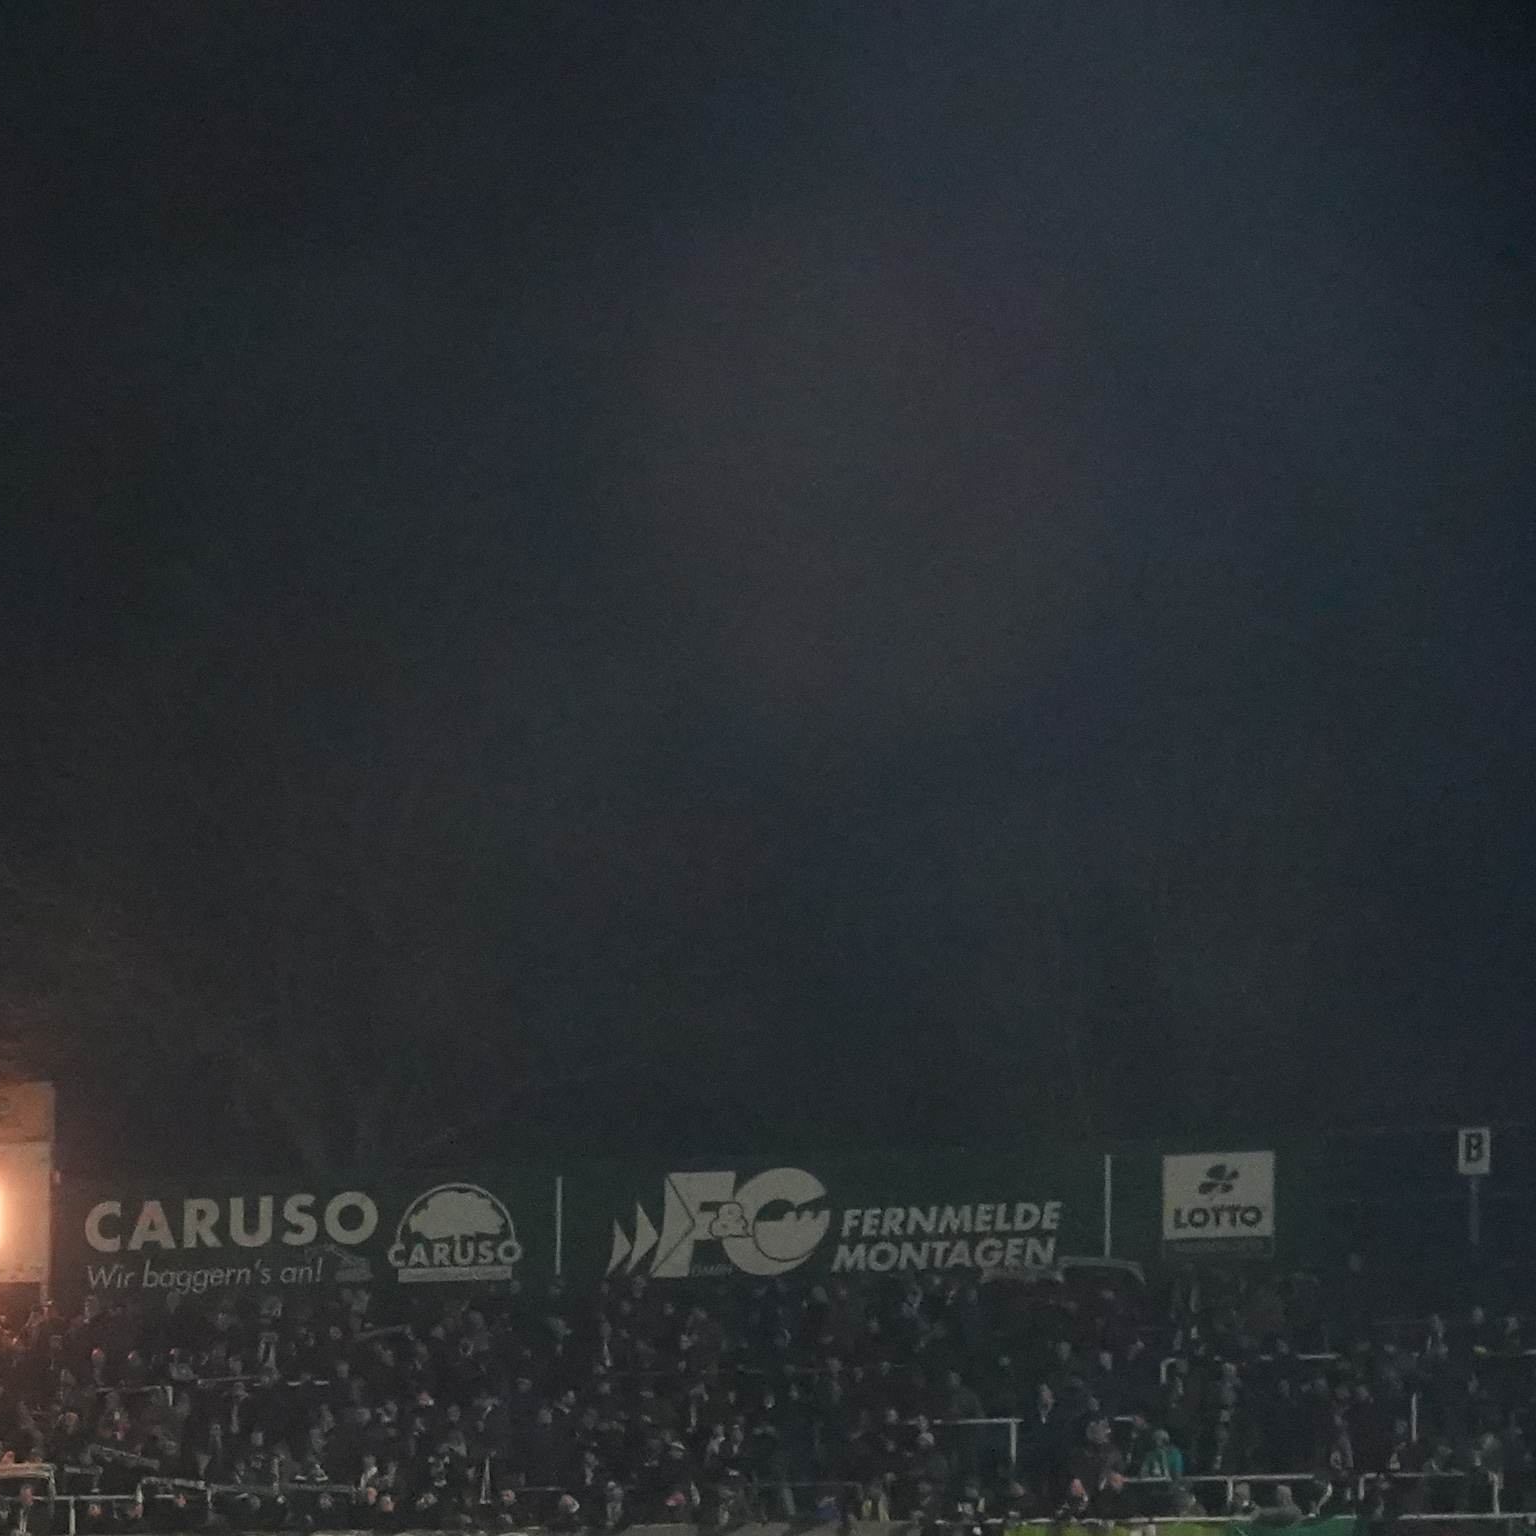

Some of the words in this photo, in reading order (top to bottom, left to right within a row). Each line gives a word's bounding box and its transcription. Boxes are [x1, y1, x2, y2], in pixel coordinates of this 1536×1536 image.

[1465, 1132, 1483, 1162] B
[83, 1190, 379, 1253] CARUSO
[839, 1200, 1065, 1239] FERNMELDE
[1173, 1204, 1262, 1229] LOTTO
[387, 1236, 524, 1269] CARUSO
[829, 1235, 1058, 1275] MONTAGEN
[86, 1262, 131, 1290] Wir
[141, 1257, 273, 1295] baggern's
[279, 1257, 325, 1285] an!
